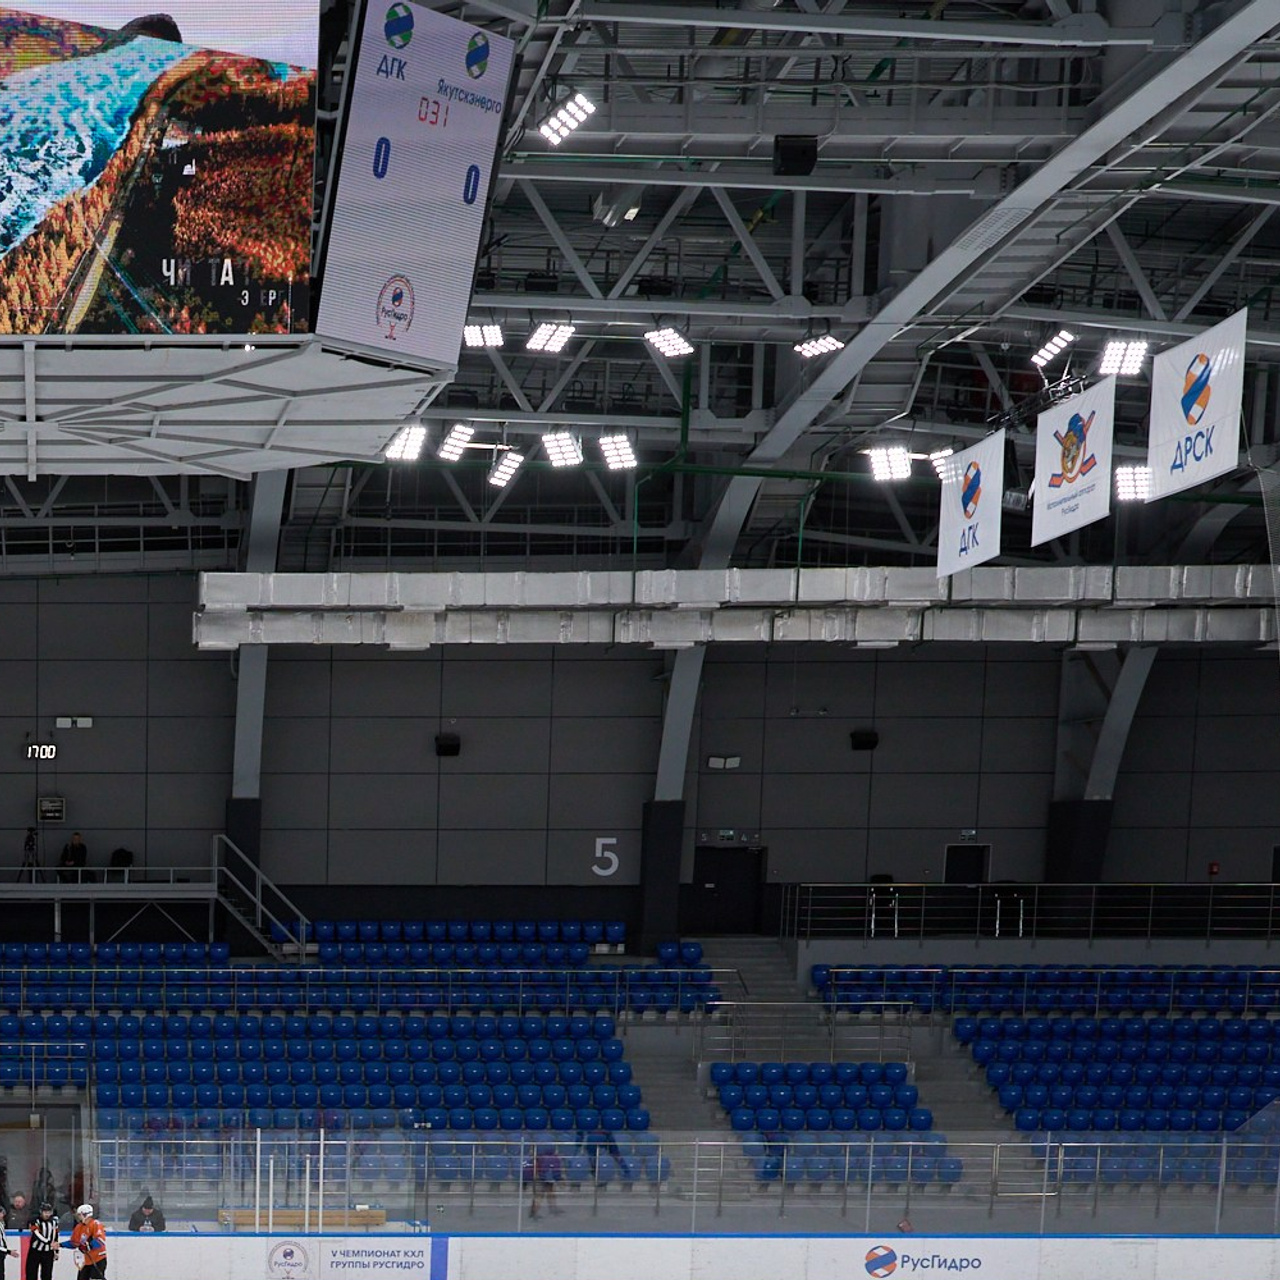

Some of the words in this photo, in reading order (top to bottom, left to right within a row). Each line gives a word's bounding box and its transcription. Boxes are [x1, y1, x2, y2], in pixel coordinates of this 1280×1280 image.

[376, 55, 408, 81] ДГК
[437, 79, 502, 114] Якутскэнерго
[372, 136, 391, 179] 0
[463, 164, 480, 205] 0
[1170, 425, 1215, 476] ДРСК
[958, 523, 980, 557] ДГК
[591, 837, 620, 876] 5
[330, 1261, 370, 1269] ГРУППЫ
[372, 1261, 425, 1270] РУСГИДРО
[340, 1250, 401, 1258] ЧЕМПИОНАТ
[403, 1250, 424, 1258] КХЛ
[901, 1255, 982, 1271] РусГидро
